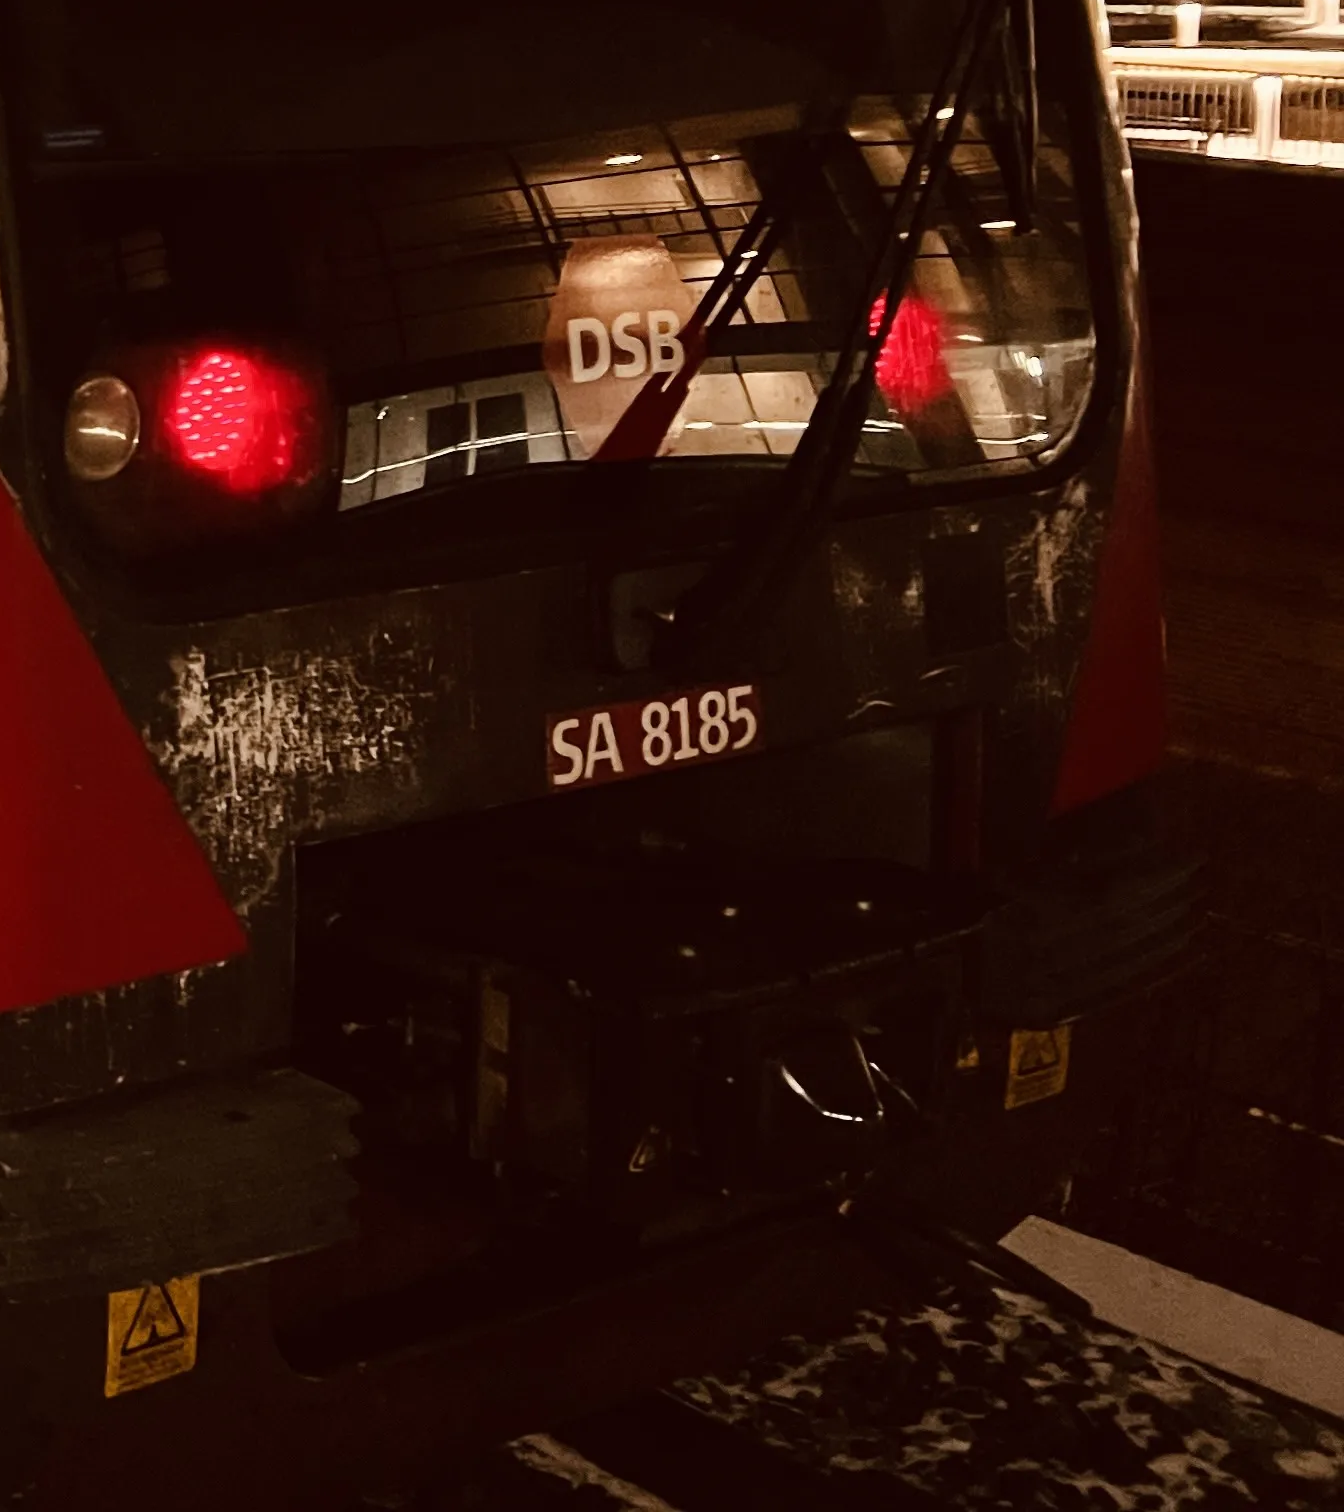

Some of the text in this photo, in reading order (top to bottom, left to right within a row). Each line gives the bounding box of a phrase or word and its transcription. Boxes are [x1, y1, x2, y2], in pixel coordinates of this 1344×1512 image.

[567, 309, 685, 384] DSB
[552, 685, 757, 785] SA 8185
